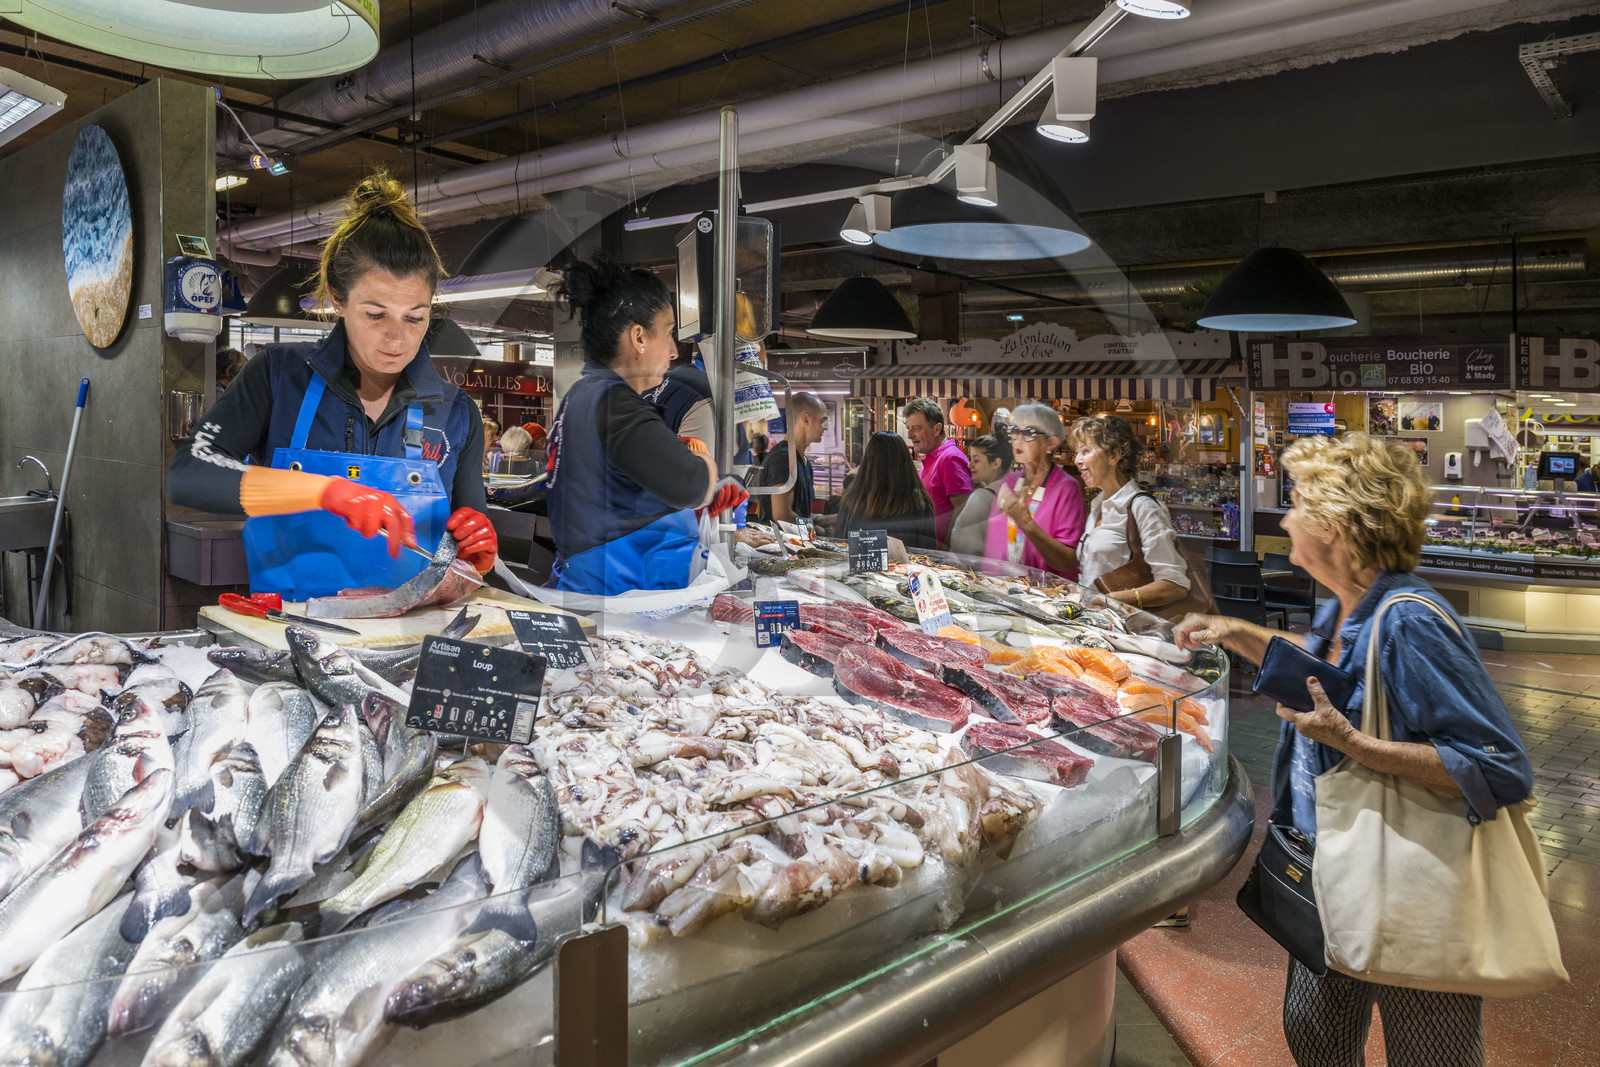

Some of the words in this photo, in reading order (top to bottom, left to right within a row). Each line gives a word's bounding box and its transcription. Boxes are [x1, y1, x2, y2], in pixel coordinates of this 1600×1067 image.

[191, 294, 214, 304] OPEF
[1000, 338, 1017, 358] La
[1019, 330, 1072, 353] tentation
[1386, 348, 1450, 360] Boucherie
[1465, 348, 1495, 364] Chez
[776, 358, 799, 368] Thierry
[1466, 364, 1495, 372] Hervé
[442, 366, 522, 391] VOLAILLES
[1388, 376, 1399, 384] 07
[1400, 376, 1412, 384] 68
[1414, 376, 1424, 384] 09
[1427, 376, 1437, 384] 15
[1439, 376, 1450, 384] 40
[1465, 372, 1472, 380] &
[1474, 372, 1496, 381] Mady
[1455, 560, 1470, 568] court
[1494, 564, 1518, 572] Aveyron
[1521, 566, 1534, 574] Tarn
[1540, 568, 1566, 576] Boucherie
[429, 640, 461, 653] Artisan
[428, 648, 459, 658] Poissonnier
[472, 660, 494, 672] Loup
